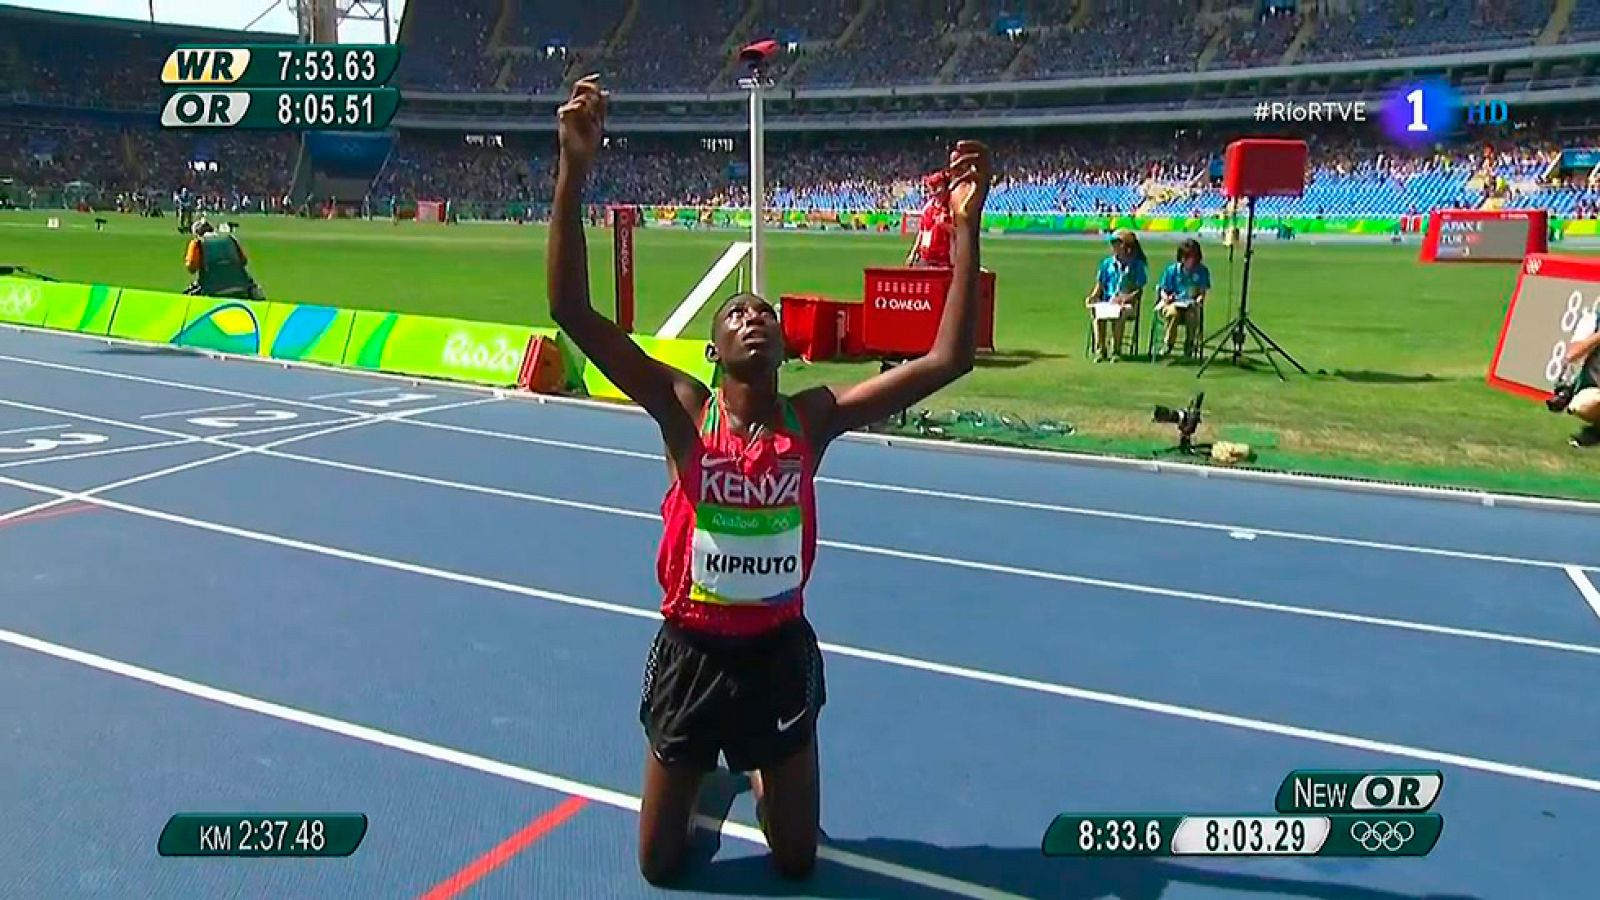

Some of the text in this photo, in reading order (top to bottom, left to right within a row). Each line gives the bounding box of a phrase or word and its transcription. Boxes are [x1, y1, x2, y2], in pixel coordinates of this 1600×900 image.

[889, 298, 931, 311] OMEGA
[700, 469, 801, 506] KENYA
[705, 553, 798, 575] KIPRUTO
